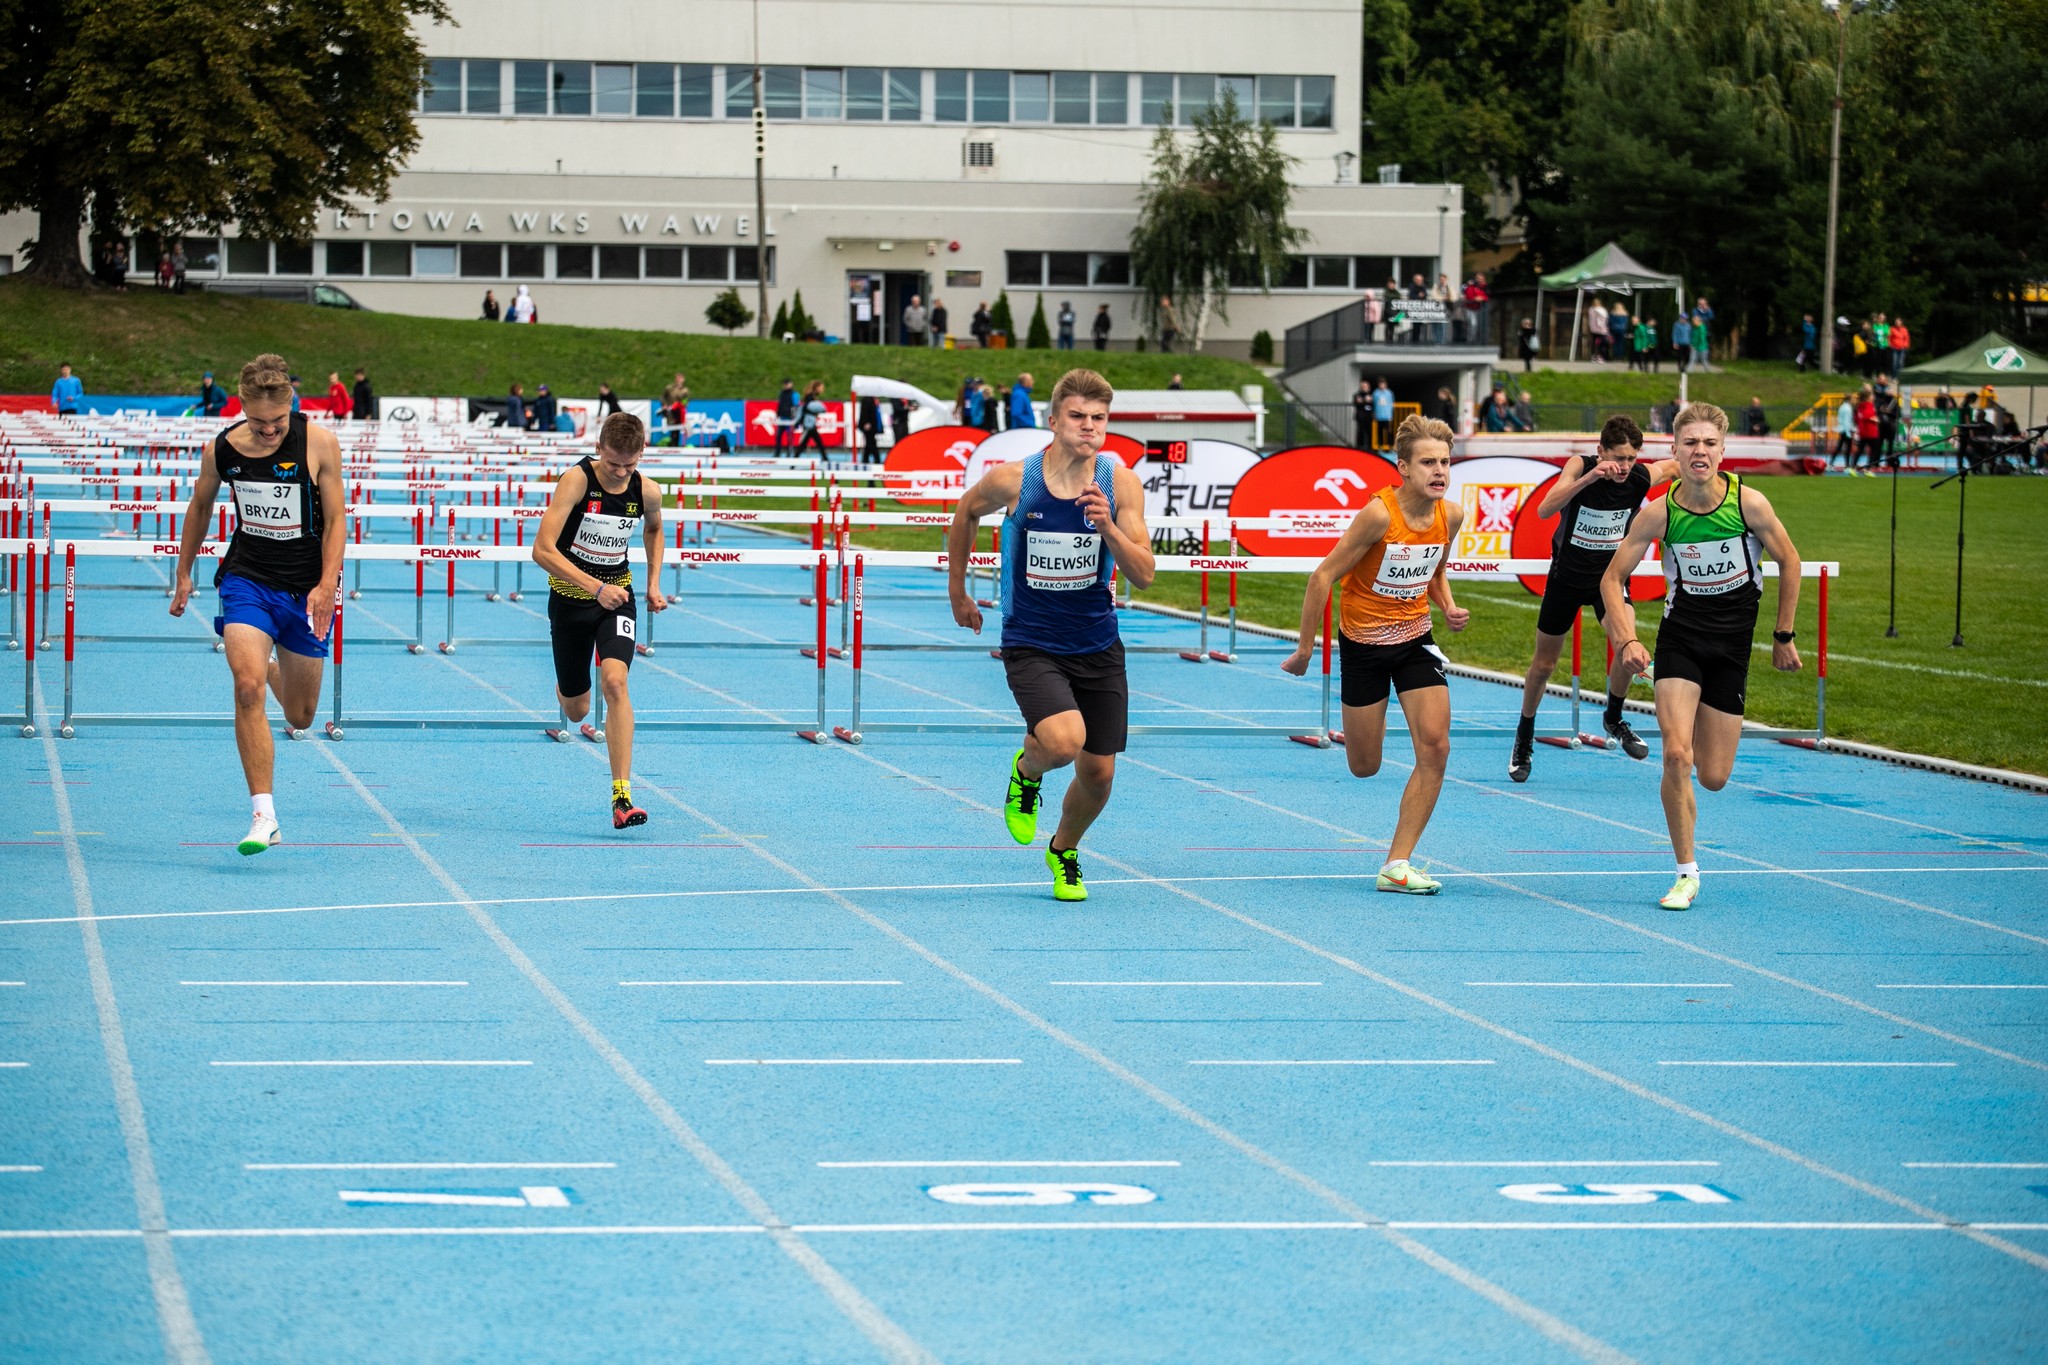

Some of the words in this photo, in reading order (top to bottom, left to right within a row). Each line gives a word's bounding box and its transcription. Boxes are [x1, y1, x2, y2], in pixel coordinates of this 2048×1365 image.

[511, 210, 590, 234] WKS
[619, 212, 778, 237] WAWEL
[273, 485, 292, 499] 37
[109, 503, 158, 511] POLANIK
[244, 503, 291, 519] BRYZA
[711, 512, 759, 520] POLANIK
[905, 515, 951, 524] POLANIK
[1027, 511, 1044, 519] esa
[1611, 510, 1625, 521] 33
[617, 518, 634, 530] 34
[1292, 520, 1337, 528] POLANIK
[1576, 521, 1625, 536] ZAKRZEWSKI
[245, 526, 275, 538] KRAKÓW
[276, 531, 295, 539] 2022
[1072, 536, 1093, 549] 36
[1576, 540, 1603, 549] KRAKÓW
[1720, 541, 1730, 554] 6
[153, 544, 216, 555] POLIK
[419, 548, 482, 559] POLANIK
[1422, 546, 1440, 559] 17
[575, 550, 607, 563] KRAKÓW
[680, 551, 741, 562] POLANIK
[1029, 554, 1097, 571] DELEWSKI
[1189, 559, 1249, 570] POLANIK
[1688, 560, 1737, 577] GLAZA
[1387, 565, 1429, 579] SAMUL
[1032, 580, 1071, 590] KRAKÓW
[1072, 579, 1091, 589] 2022
[1690, 584, 1724, 594] KRAKÓW
[1725, 578, 1743, 590] 2022
[1379, 587, 1412, 597] KRAKÓW
[1412, 586, 1426, 596] 2022
[622, 620, 631, 634] 6
